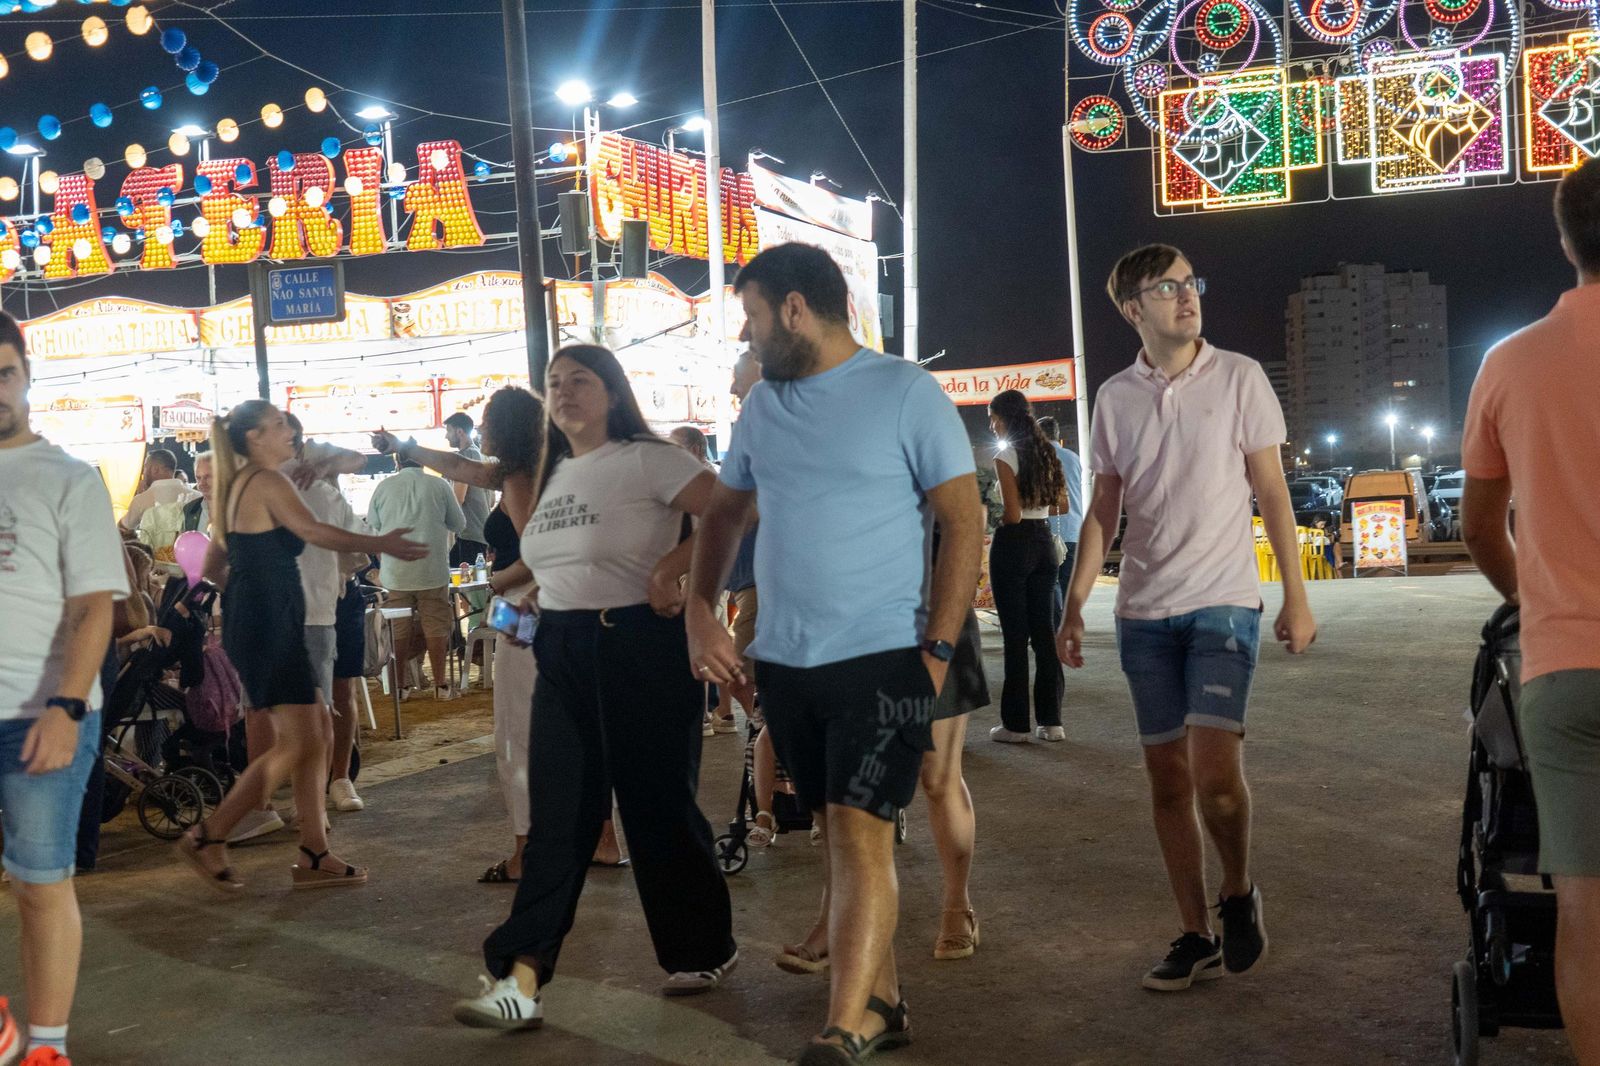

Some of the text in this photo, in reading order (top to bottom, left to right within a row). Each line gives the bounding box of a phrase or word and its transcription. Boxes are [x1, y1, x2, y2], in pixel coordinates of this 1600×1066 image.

[285, 272, 319, 286] CALLE
[479, 275, 523, 288] Artesan
[272, 285, 335, 301] NAO SANTA
[286, 302, 322, 315] MARÍA
[417, 294, 572, 334] CAFETEA
[939, 373, 1031, 394] oda la Vida
